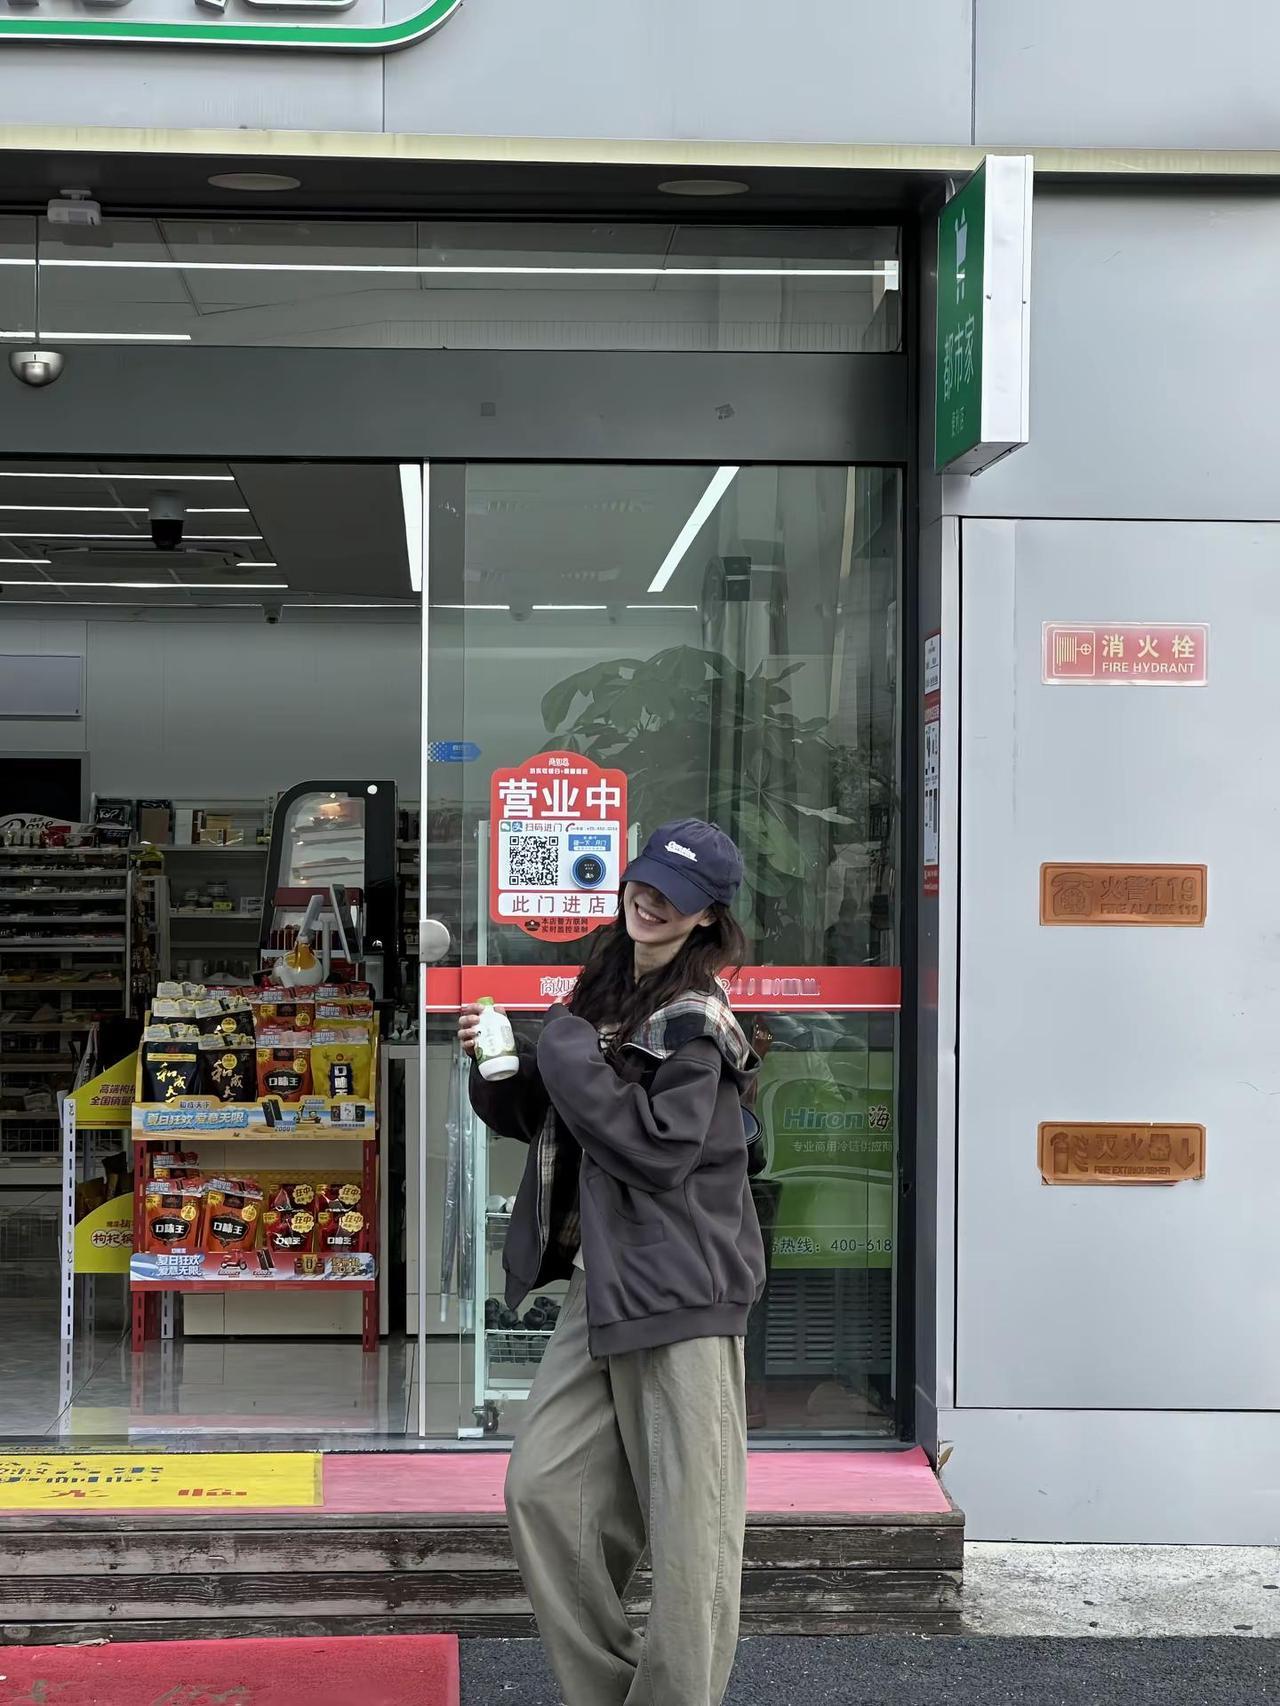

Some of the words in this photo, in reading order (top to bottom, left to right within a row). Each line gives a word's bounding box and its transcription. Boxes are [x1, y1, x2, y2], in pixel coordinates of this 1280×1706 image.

[1101, 633, 1196, 659] 消火栓
[1102, 662, 1129, 673] FIRE
[1133, 662, 1196, 674] HYDRANT
[498, 778, 621, 819] 营业中
[525, 823, 563, 833] 扫码进门
[511, 895, 606, 914] 此门进店
[784, 1107, 863, 1129] Hiron
[868, 1104, 891, 1131] 海
[1094, 1133, 1172, 1162] 灭火器
[154, 1223, 185, 1234] 口味王
[212, 1222, 243, 1235] 口味王
[156, 1254, 201, 1265] 夏日狂欢
